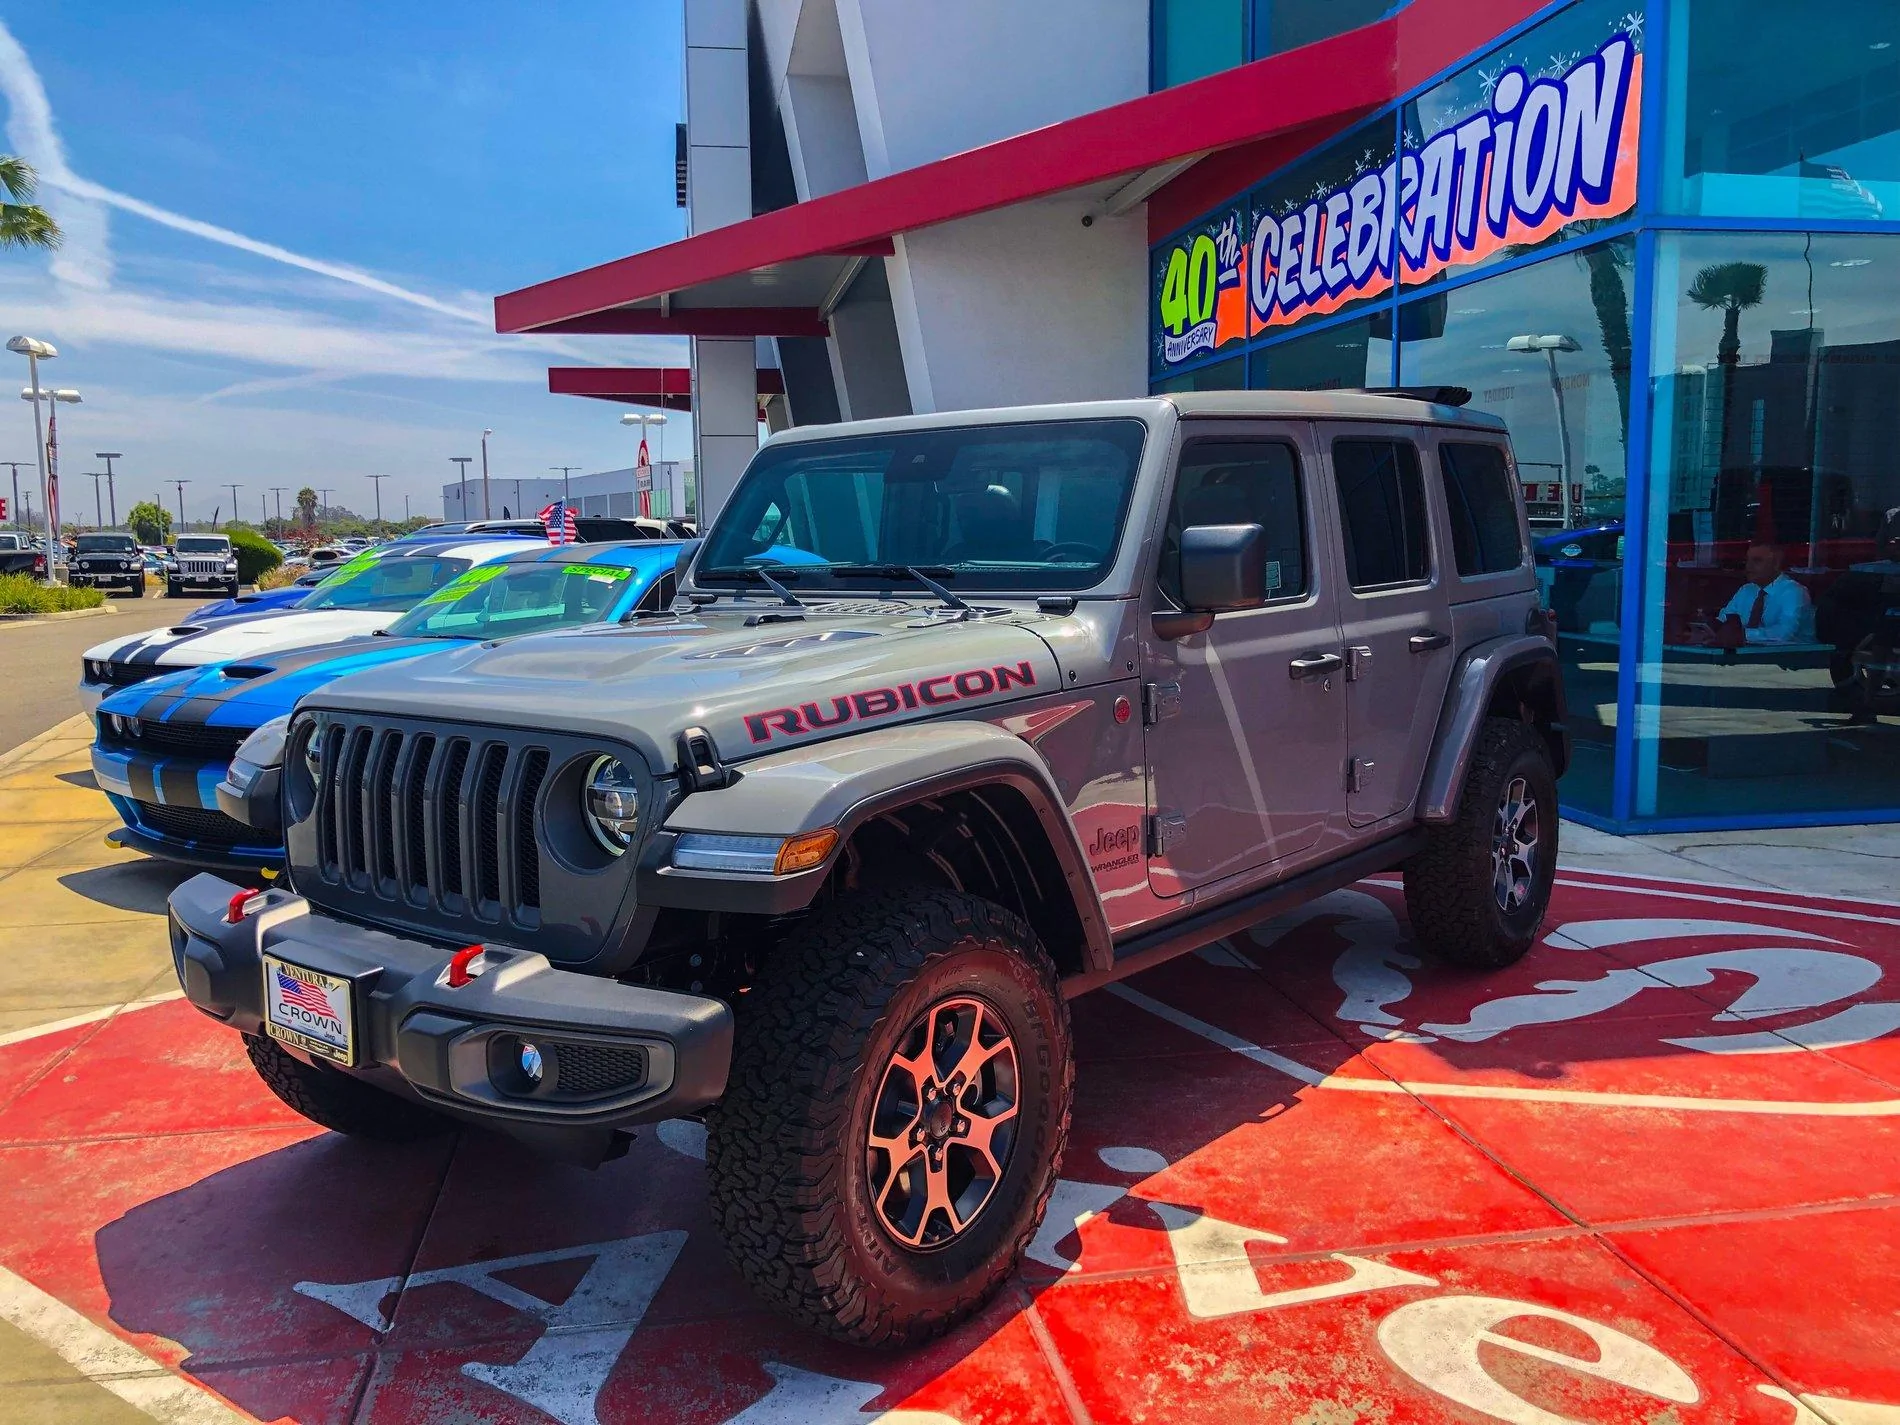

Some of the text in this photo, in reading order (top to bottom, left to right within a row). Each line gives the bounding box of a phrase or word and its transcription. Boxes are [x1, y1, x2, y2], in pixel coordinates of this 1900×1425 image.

[1167, 326, 1214, 358] ANNIVERSARY
[571, 566, 623, 578] SPECIAL
[743, 660, 1037, 745] RUBICON
[1089, 824, 1140, 857] Jeep
[1090, 853, 1139, 874] WRANGLER
[282, 962, 326, 988] VENTURA
[278, 1002, 343, 1035] CROWN
[269, 1023, 300, 1046] CROWN
